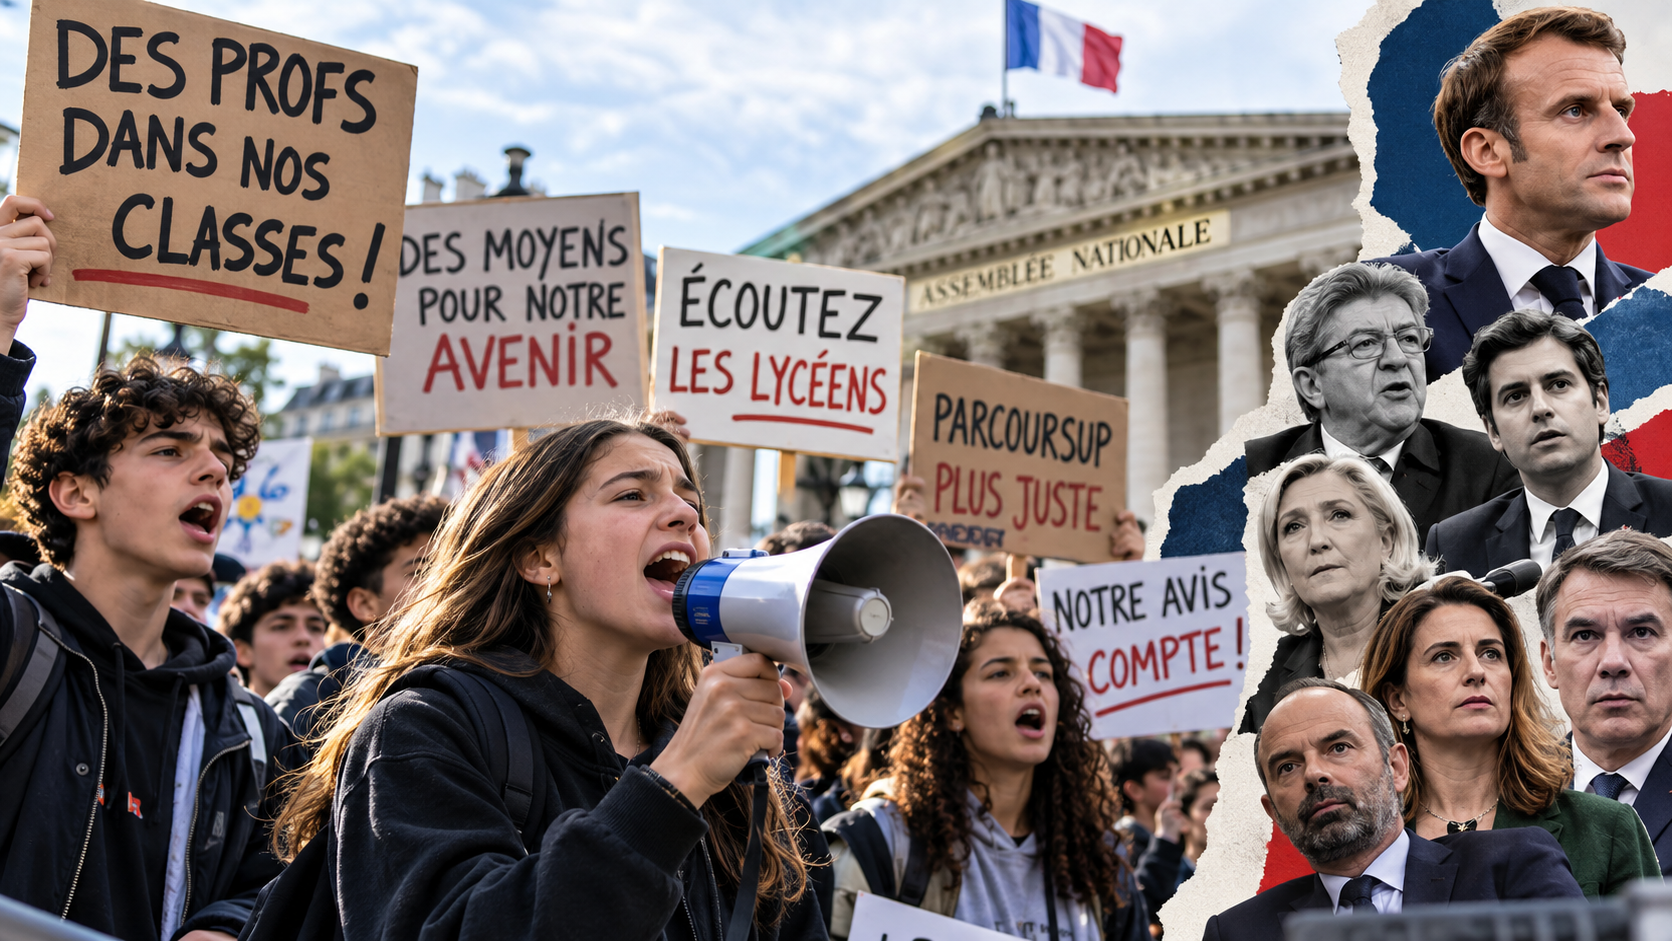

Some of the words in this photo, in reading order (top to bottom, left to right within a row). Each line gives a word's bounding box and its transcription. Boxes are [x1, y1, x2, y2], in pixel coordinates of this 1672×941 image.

[56, 19, 186, 99] DES
[211, 38, 377, 134] PROFS
[59, 107, 218, 178] DANS
[240, 136, 330, 201] NOS
[399, 231, 466, 277] DES
[484, 218, 629, 281] MOYENS
[919, 253, 1055, 308] ASSEMBLÉE
[1071, 218, 1212, 275] NATIONALE
[419, 285, 506, 326] POUR
[526, 282, 626, 322] NOTRE
[679, 263, 883, 343] ÉCOUTEZ
[422, 322, 619, 394] AVENIR
[669, 346, 734, 395] LES
[750, 349, 887, 415] LYCÉENS
[933, 392, 1112, 468] PARCOURSUP
[934, 461, 1003, 518] PLUS
[1012, 474, 1103, 532] JUSTE
[1053, 581, 1146, 634] NOTRE
[1161, 565, 1232, 618] AVIS
